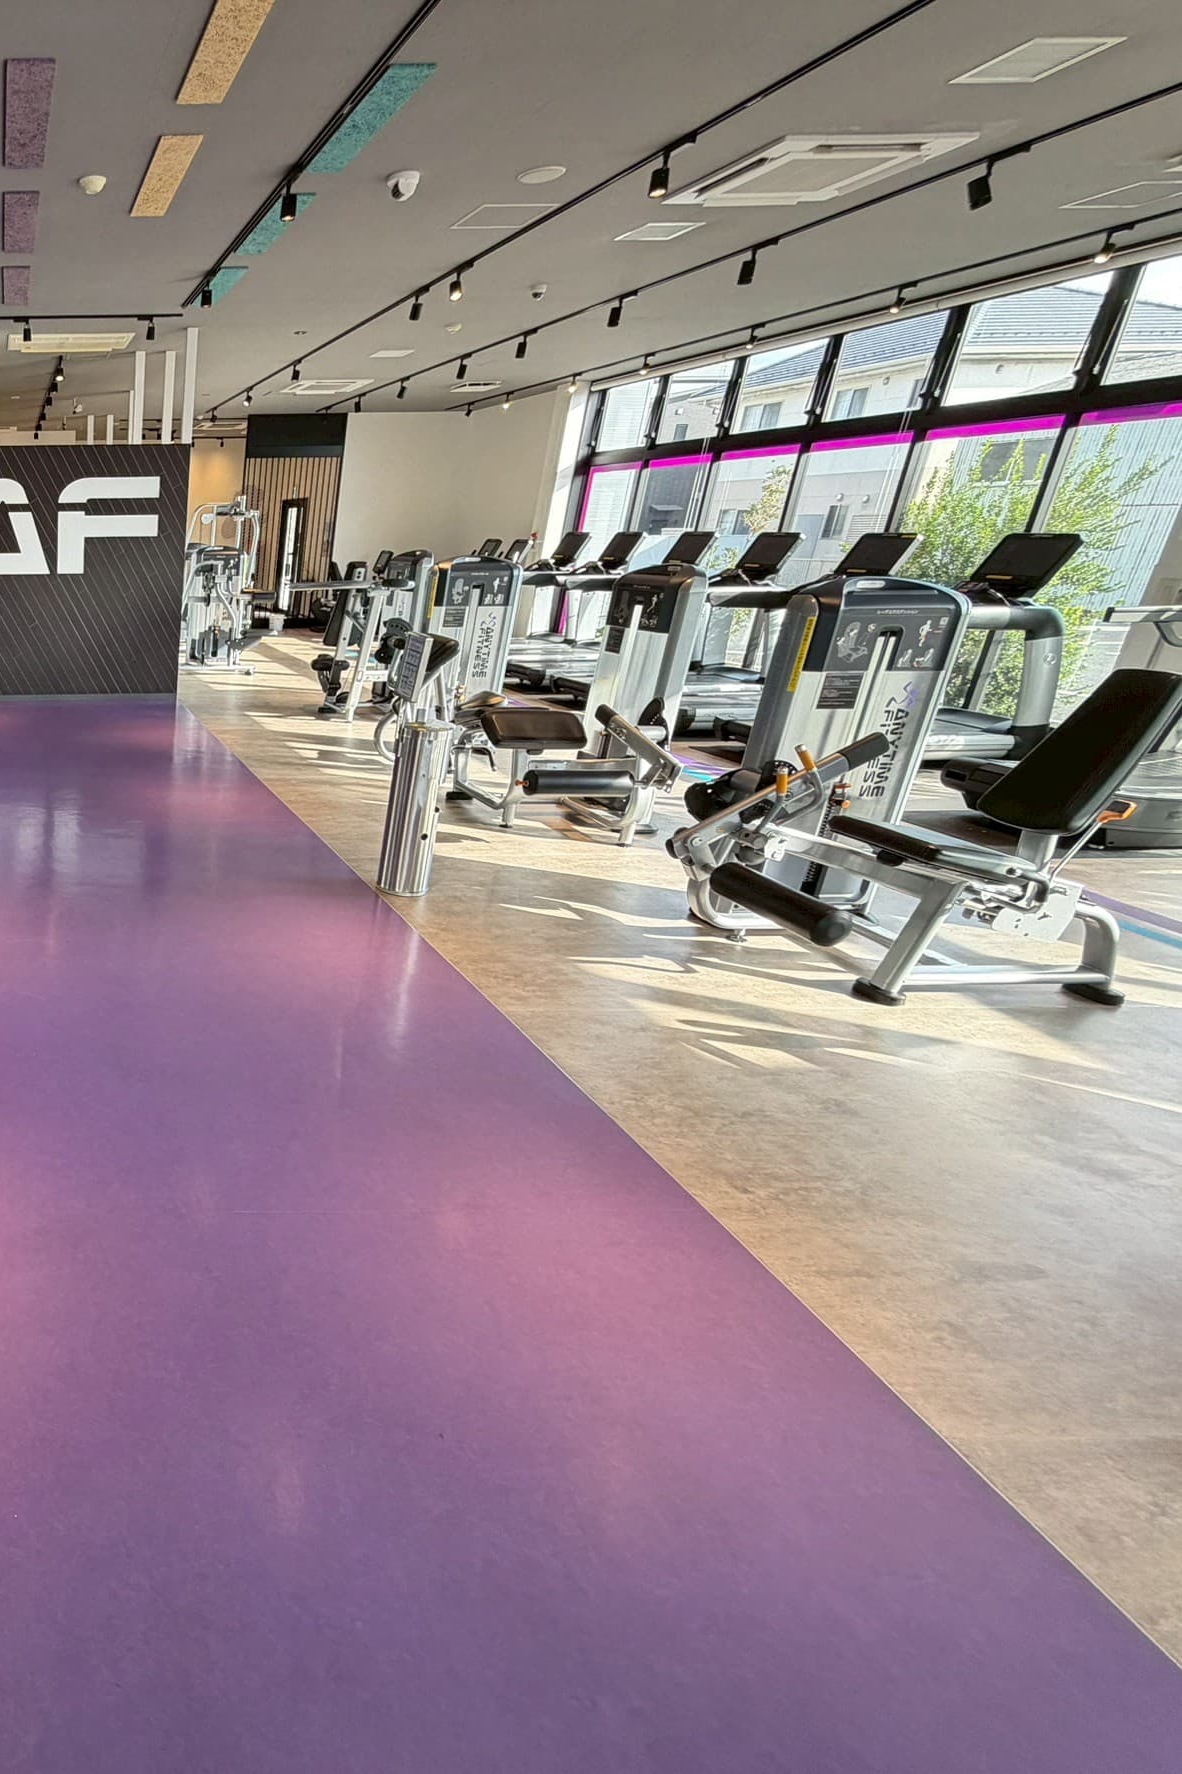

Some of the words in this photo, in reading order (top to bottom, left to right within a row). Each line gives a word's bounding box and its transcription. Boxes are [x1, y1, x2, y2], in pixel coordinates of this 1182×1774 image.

[471, 627, 486, 678] FITNESS
[478, 627, 494, 678] ANYTIME
[859, 709, 894, 797] FIESS
[870, 708, 909, 797] ANYTIME
